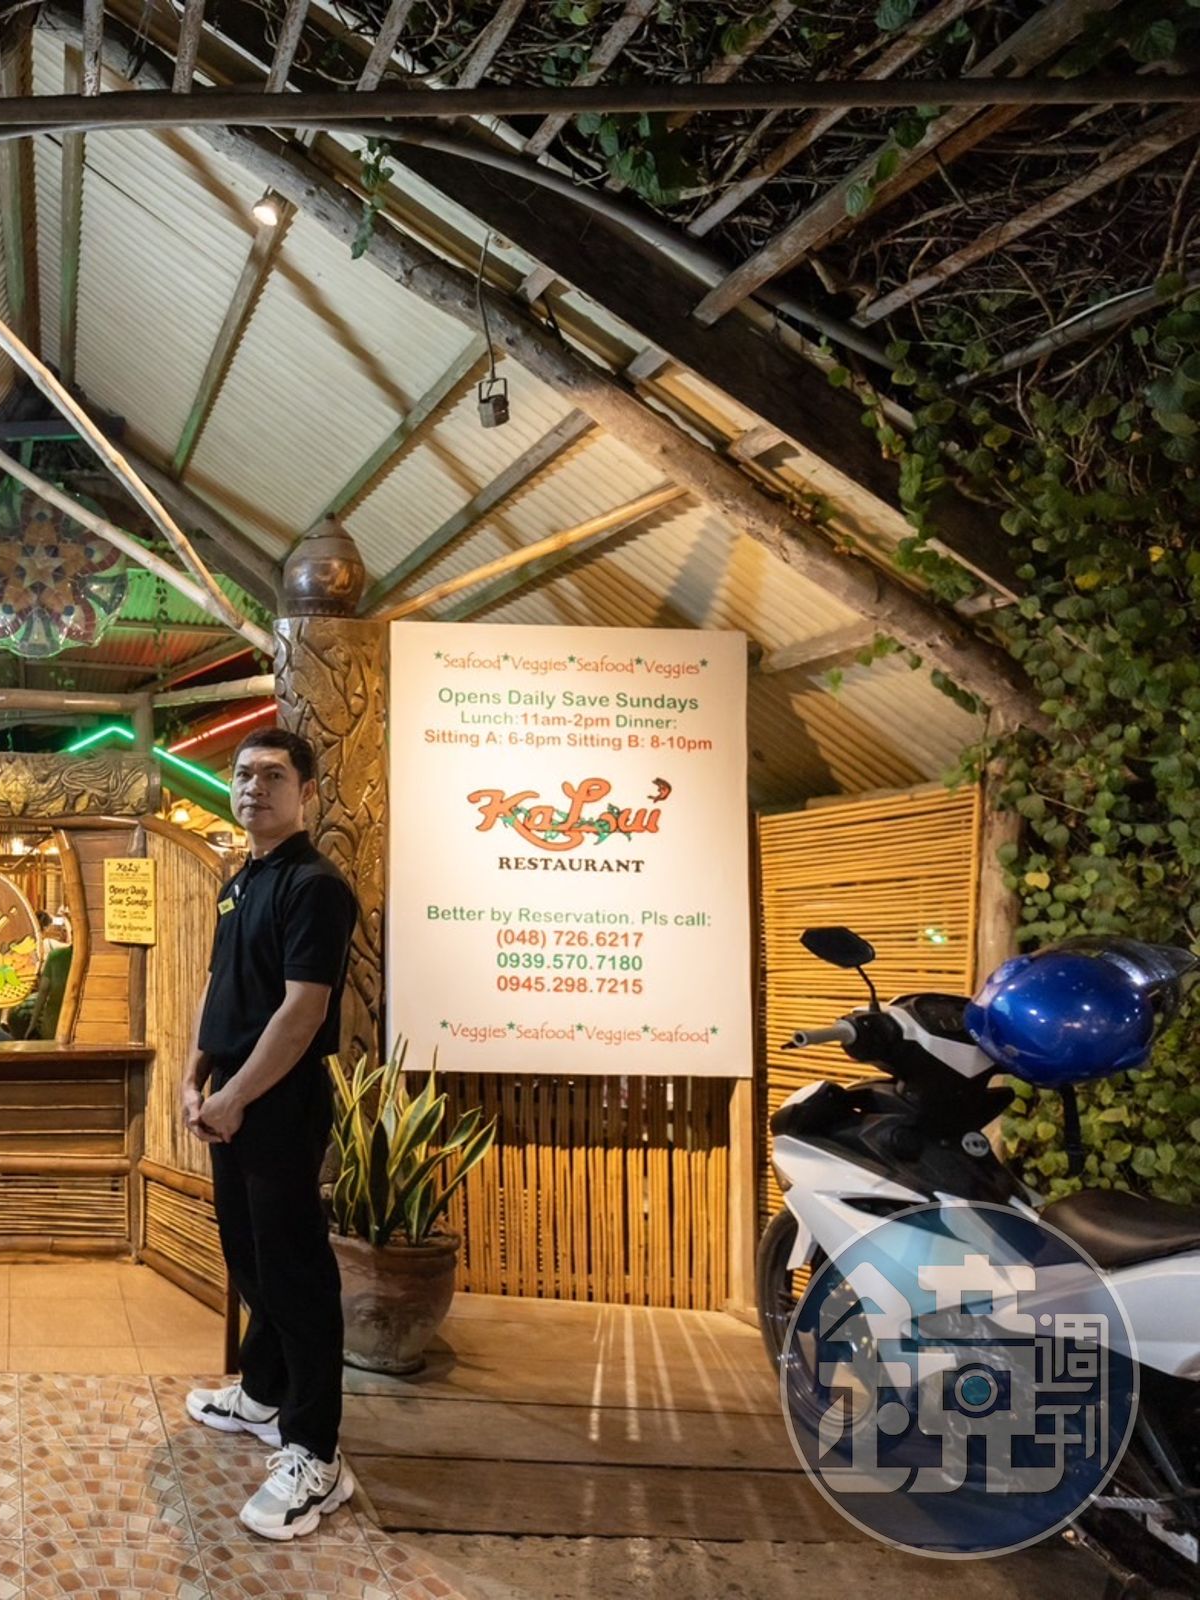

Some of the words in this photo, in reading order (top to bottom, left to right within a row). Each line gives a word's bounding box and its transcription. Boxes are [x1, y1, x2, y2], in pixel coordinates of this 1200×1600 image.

[438, 687, 501, 706] Opens
[508, 689, 556, 709] Daily
[562, 691, 610, 707] Save
[615, 692, 699, 713] Sundays
[615, 714, 677, 730] Dinner:
[424, 729, 480, 748] Sitting
[485, 731, 503, 745] A:
[508, 731, 561, 748] 6-8pm
[566, 732, 622, 751] Sitting
[628, 734, 645, 748] B:
[650, 735, 713, 751] 8-10pm
[498, 856, 645, 873] RESTAURANT
[427, 905, 485, 921] Better
[491, 907, 512, 924] by
[518, 907, 634, 925] Reservation.
[641, 911, 668, 926] Pls
[674, 912, 712, 927] call:
[496, 928, 547, 949] (048)
[553, 930, 644, 948] 726.6217
[496, 952, 643, 971] 0939.570.7180
[496, 975, 643, 994] 0945.298.7215
